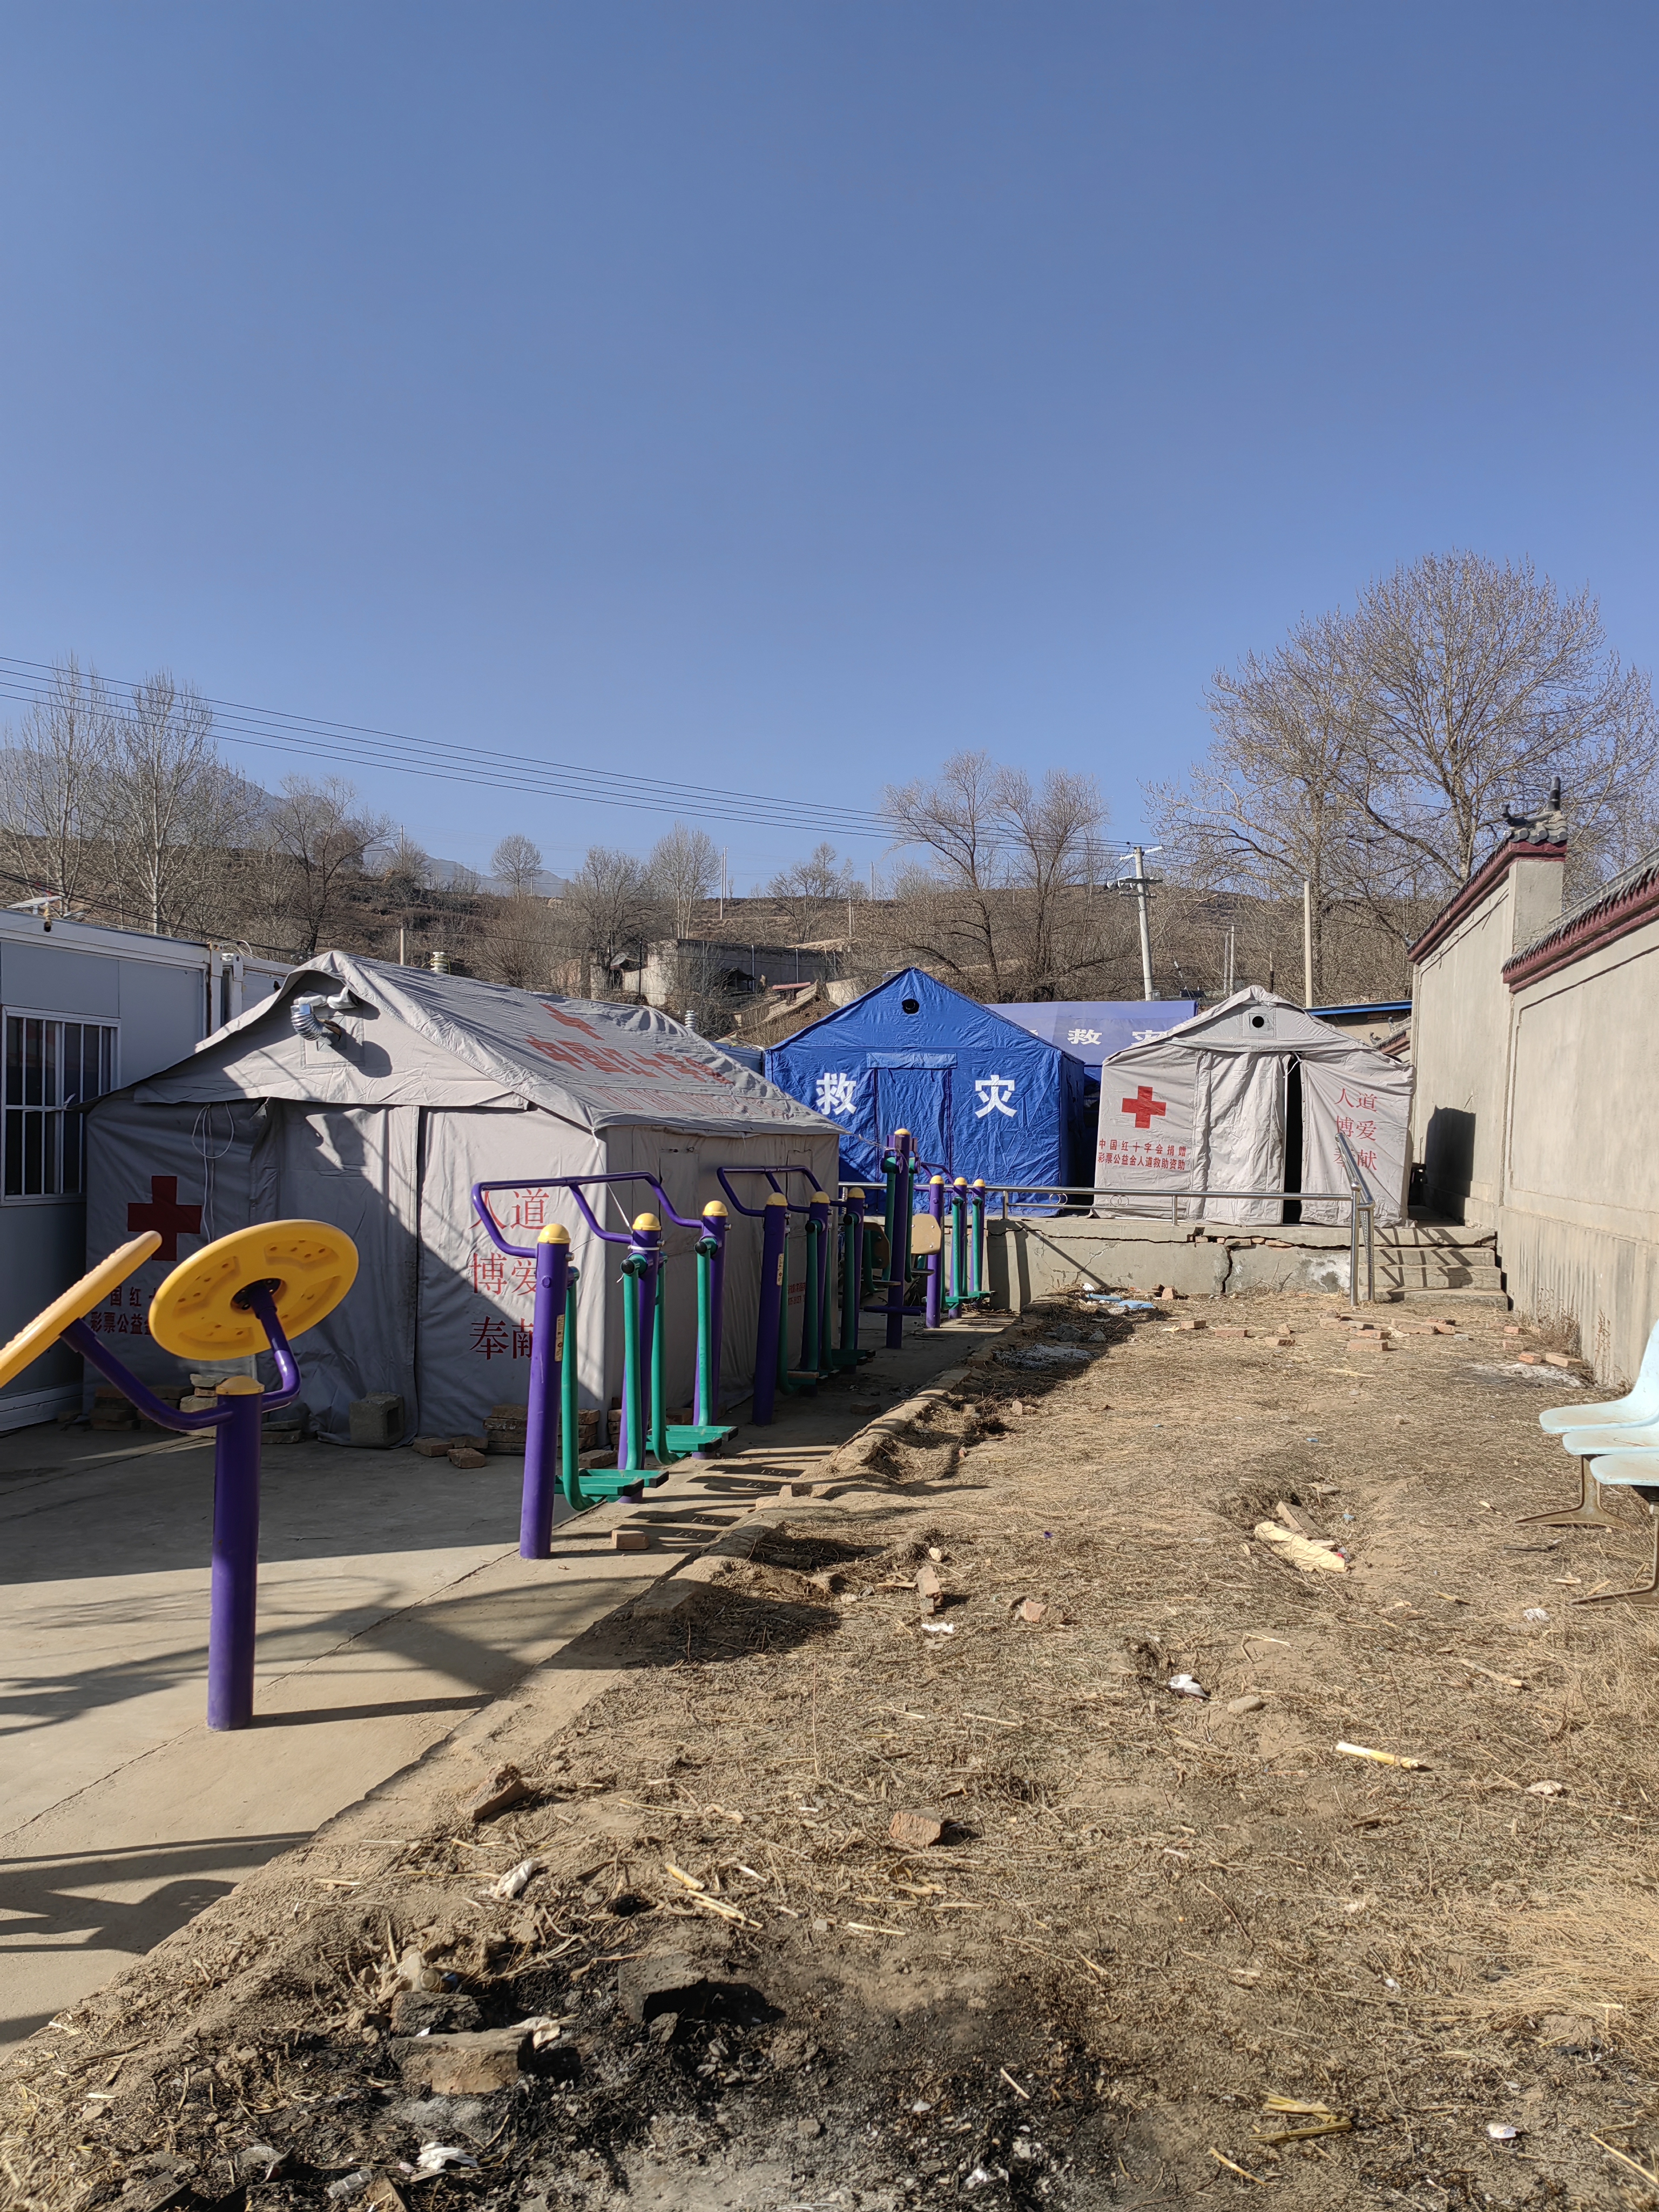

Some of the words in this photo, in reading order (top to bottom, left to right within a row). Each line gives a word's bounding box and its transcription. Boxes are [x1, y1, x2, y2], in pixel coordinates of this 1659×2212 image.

[524, 1035, 734, 1085] 中国红十字会
[816, 1073, 857, 1115] 救
[974, 1075, 1017, 1118] 灾
[1334, 1088, 1378, 1112] 人道
[1334, 1115, 1377, 1142] 博爱
[1097, 1152, 1185, 1171] 彩票公益金人道救助资助
[1098, 1138, 1187, 1157] 中国红十字会捐赠
[468, 1188, 549, 1230] 人道
[469, 1252, 536, 1296] 博爱
